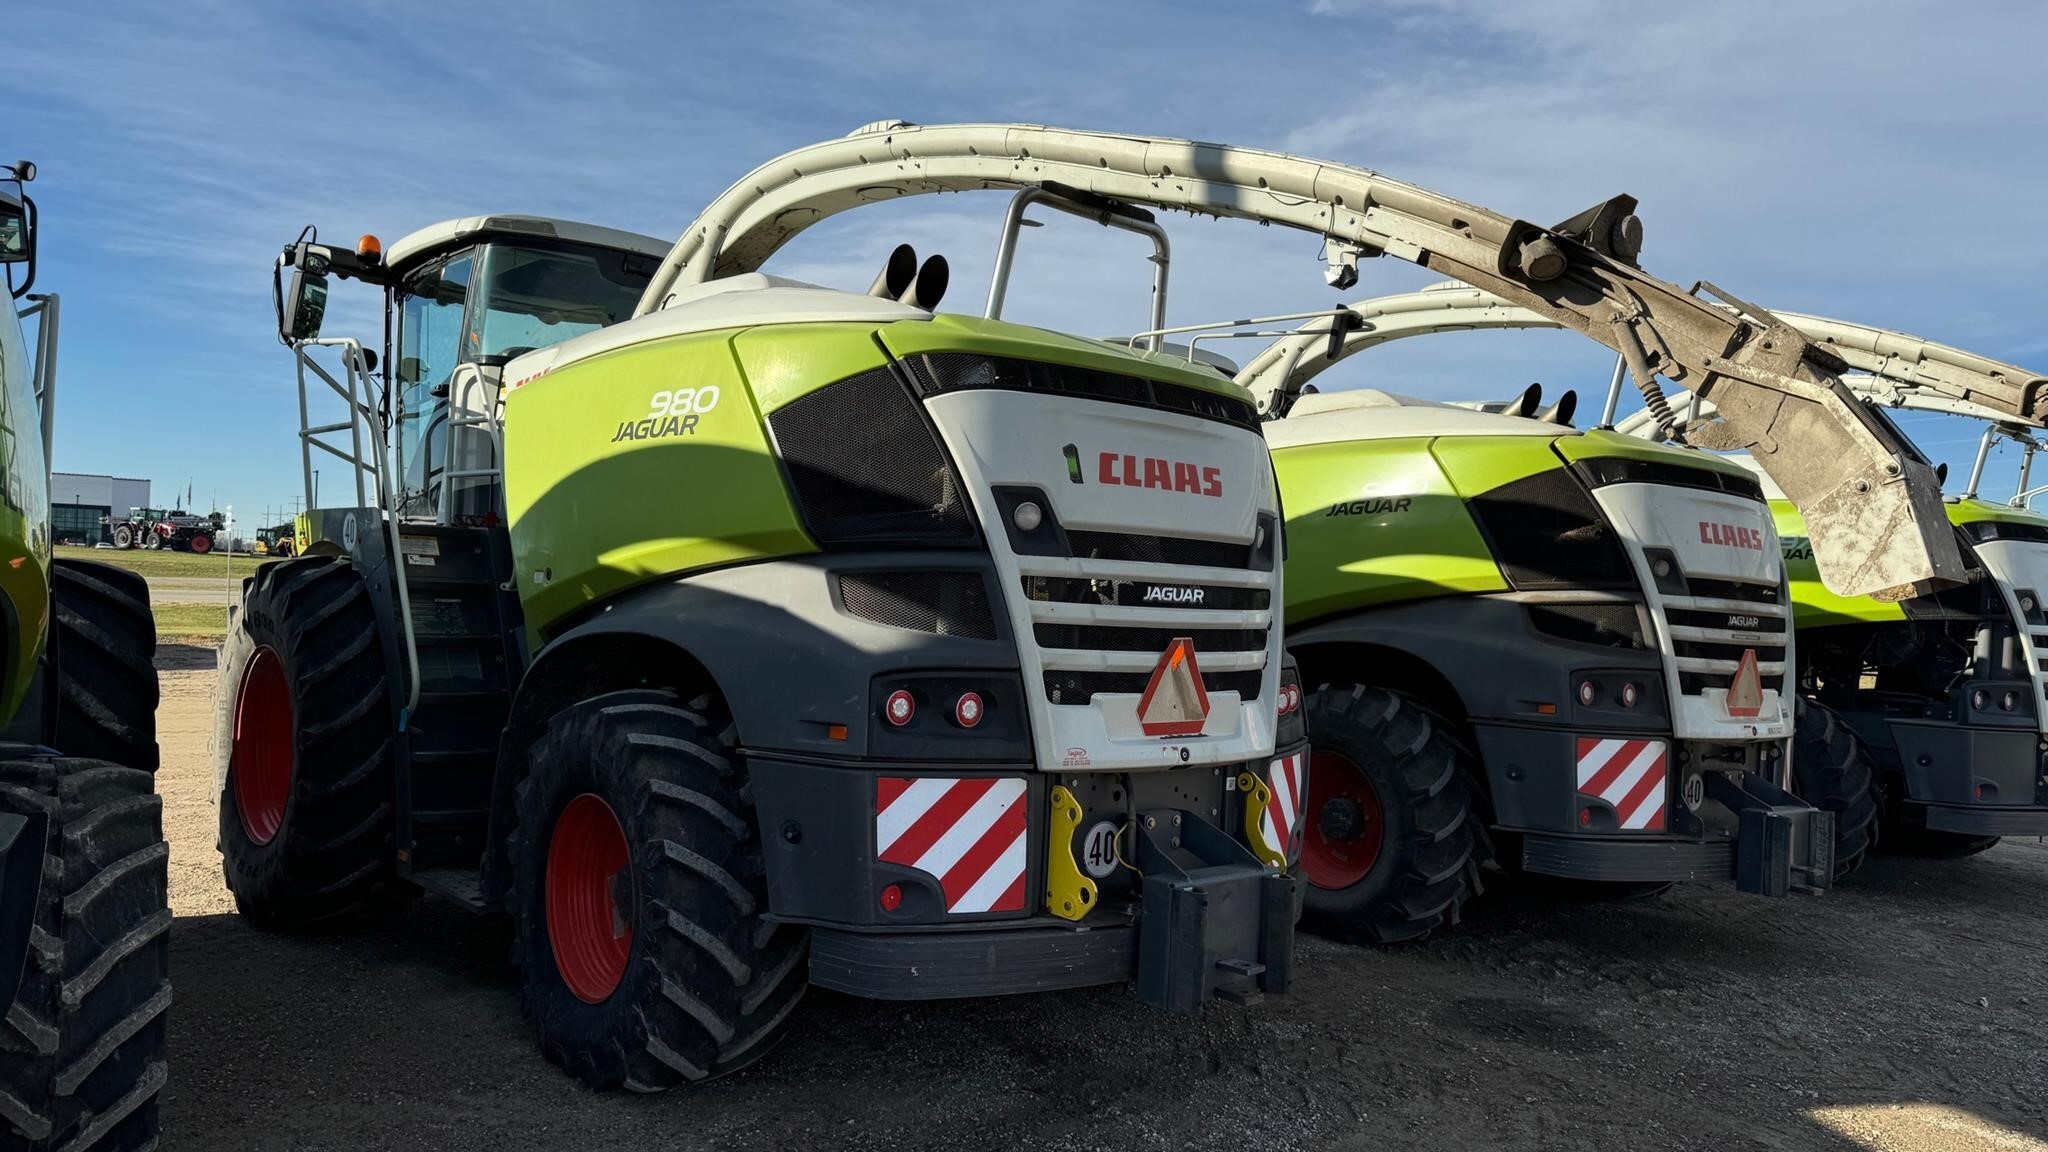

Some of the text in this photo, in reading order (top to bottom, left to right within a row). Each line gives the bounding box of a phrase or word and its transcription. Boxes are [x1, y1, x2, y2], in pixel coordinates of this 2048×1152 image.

[647, 385, 720, 419] 980
[611, 414, 699, 442] JAGUAR
[1099, 452, 1222, 497] CLAAS
[1326, 498, 1412, 517] JAGUAR
[344, 517, 356, 544] 40
[1699, 521, 1762, 551] CLAAS
[1143, 586, 1204, 602] JAGUAR
[1728, 616, 1759, 627] JAGUAR
[1687, 780, 1701, 803] 40
[1090, 830, 1115, 866] 40
